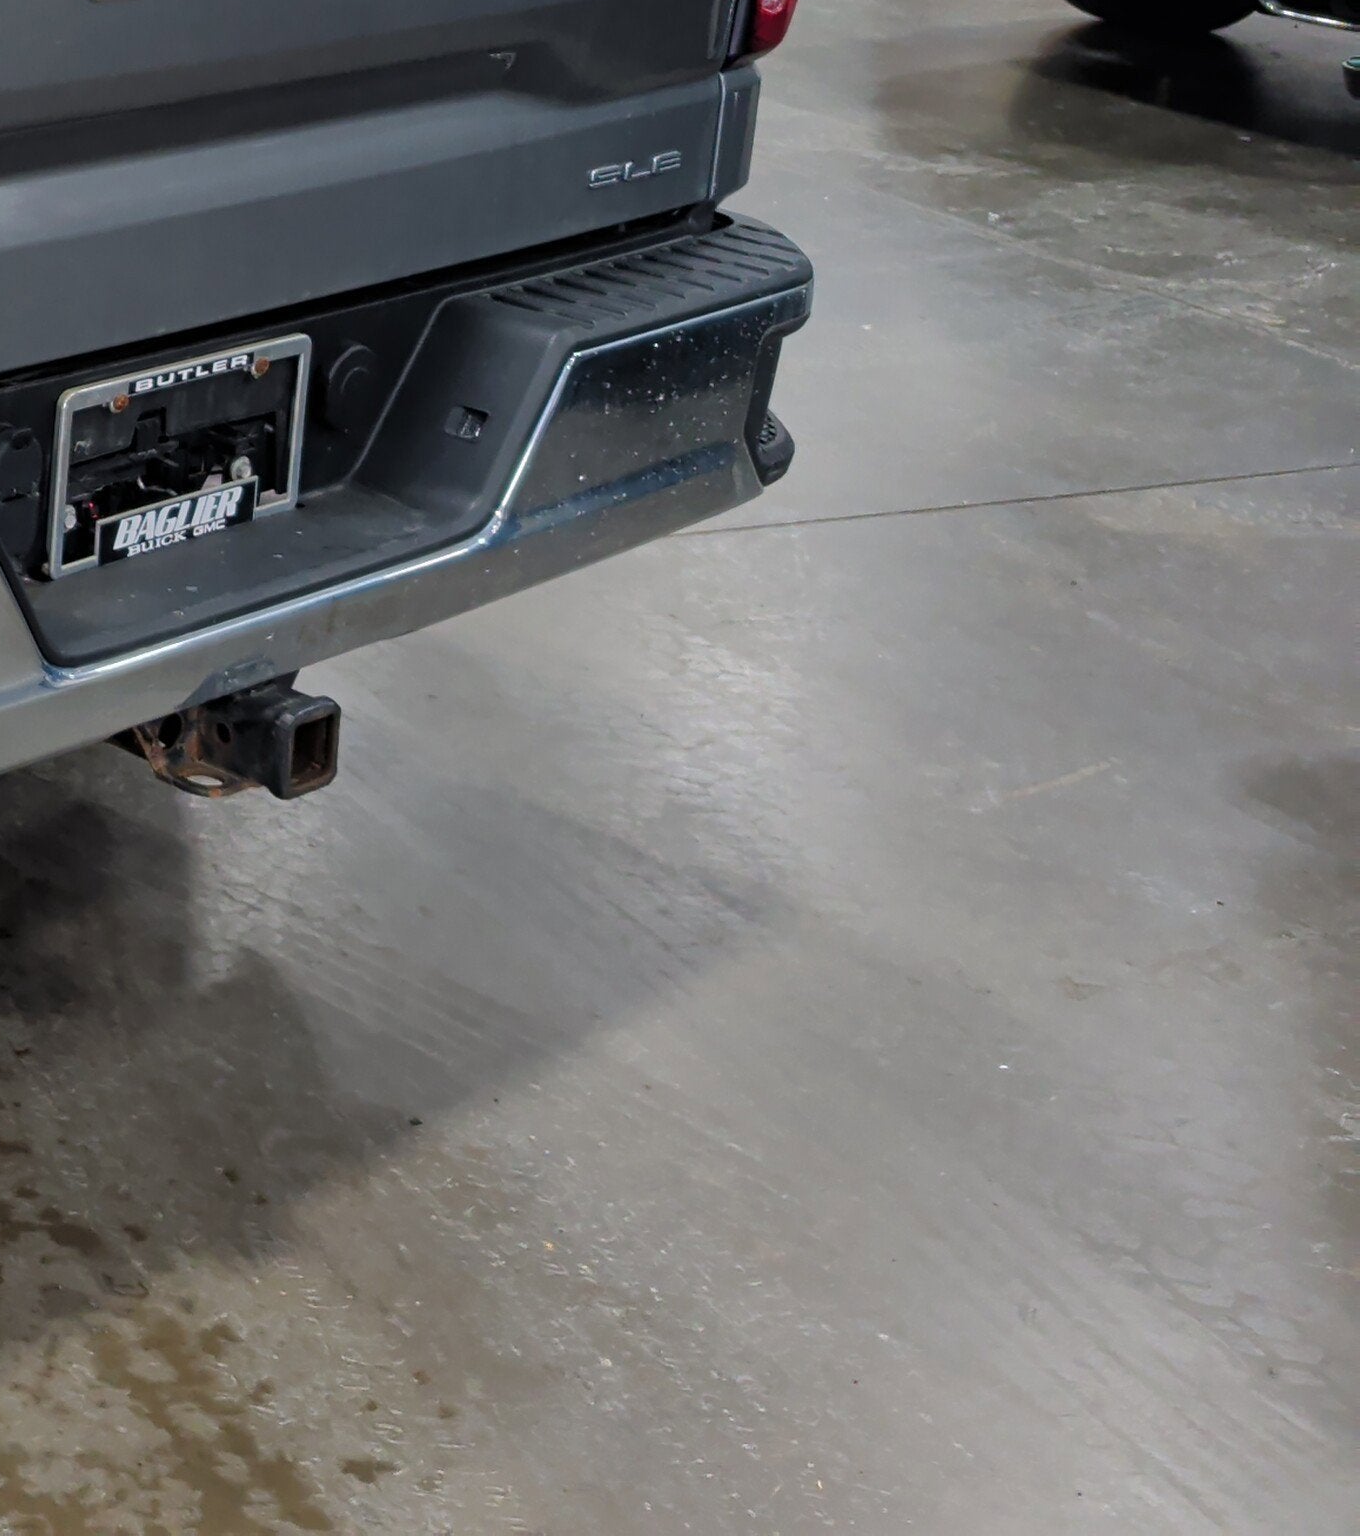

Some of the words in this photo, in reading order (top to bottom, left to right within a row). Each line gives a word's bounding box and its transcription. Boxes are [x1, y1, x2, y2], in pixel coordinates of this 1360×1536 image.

[588, 150, 682, 189] SLE
[135, 354, 250, 393] BUTLER
[112, 485, 243, 551] BAGLIER
[127, 530, 186, 558] BUICK
[193, 518, 226, 537] GMC
